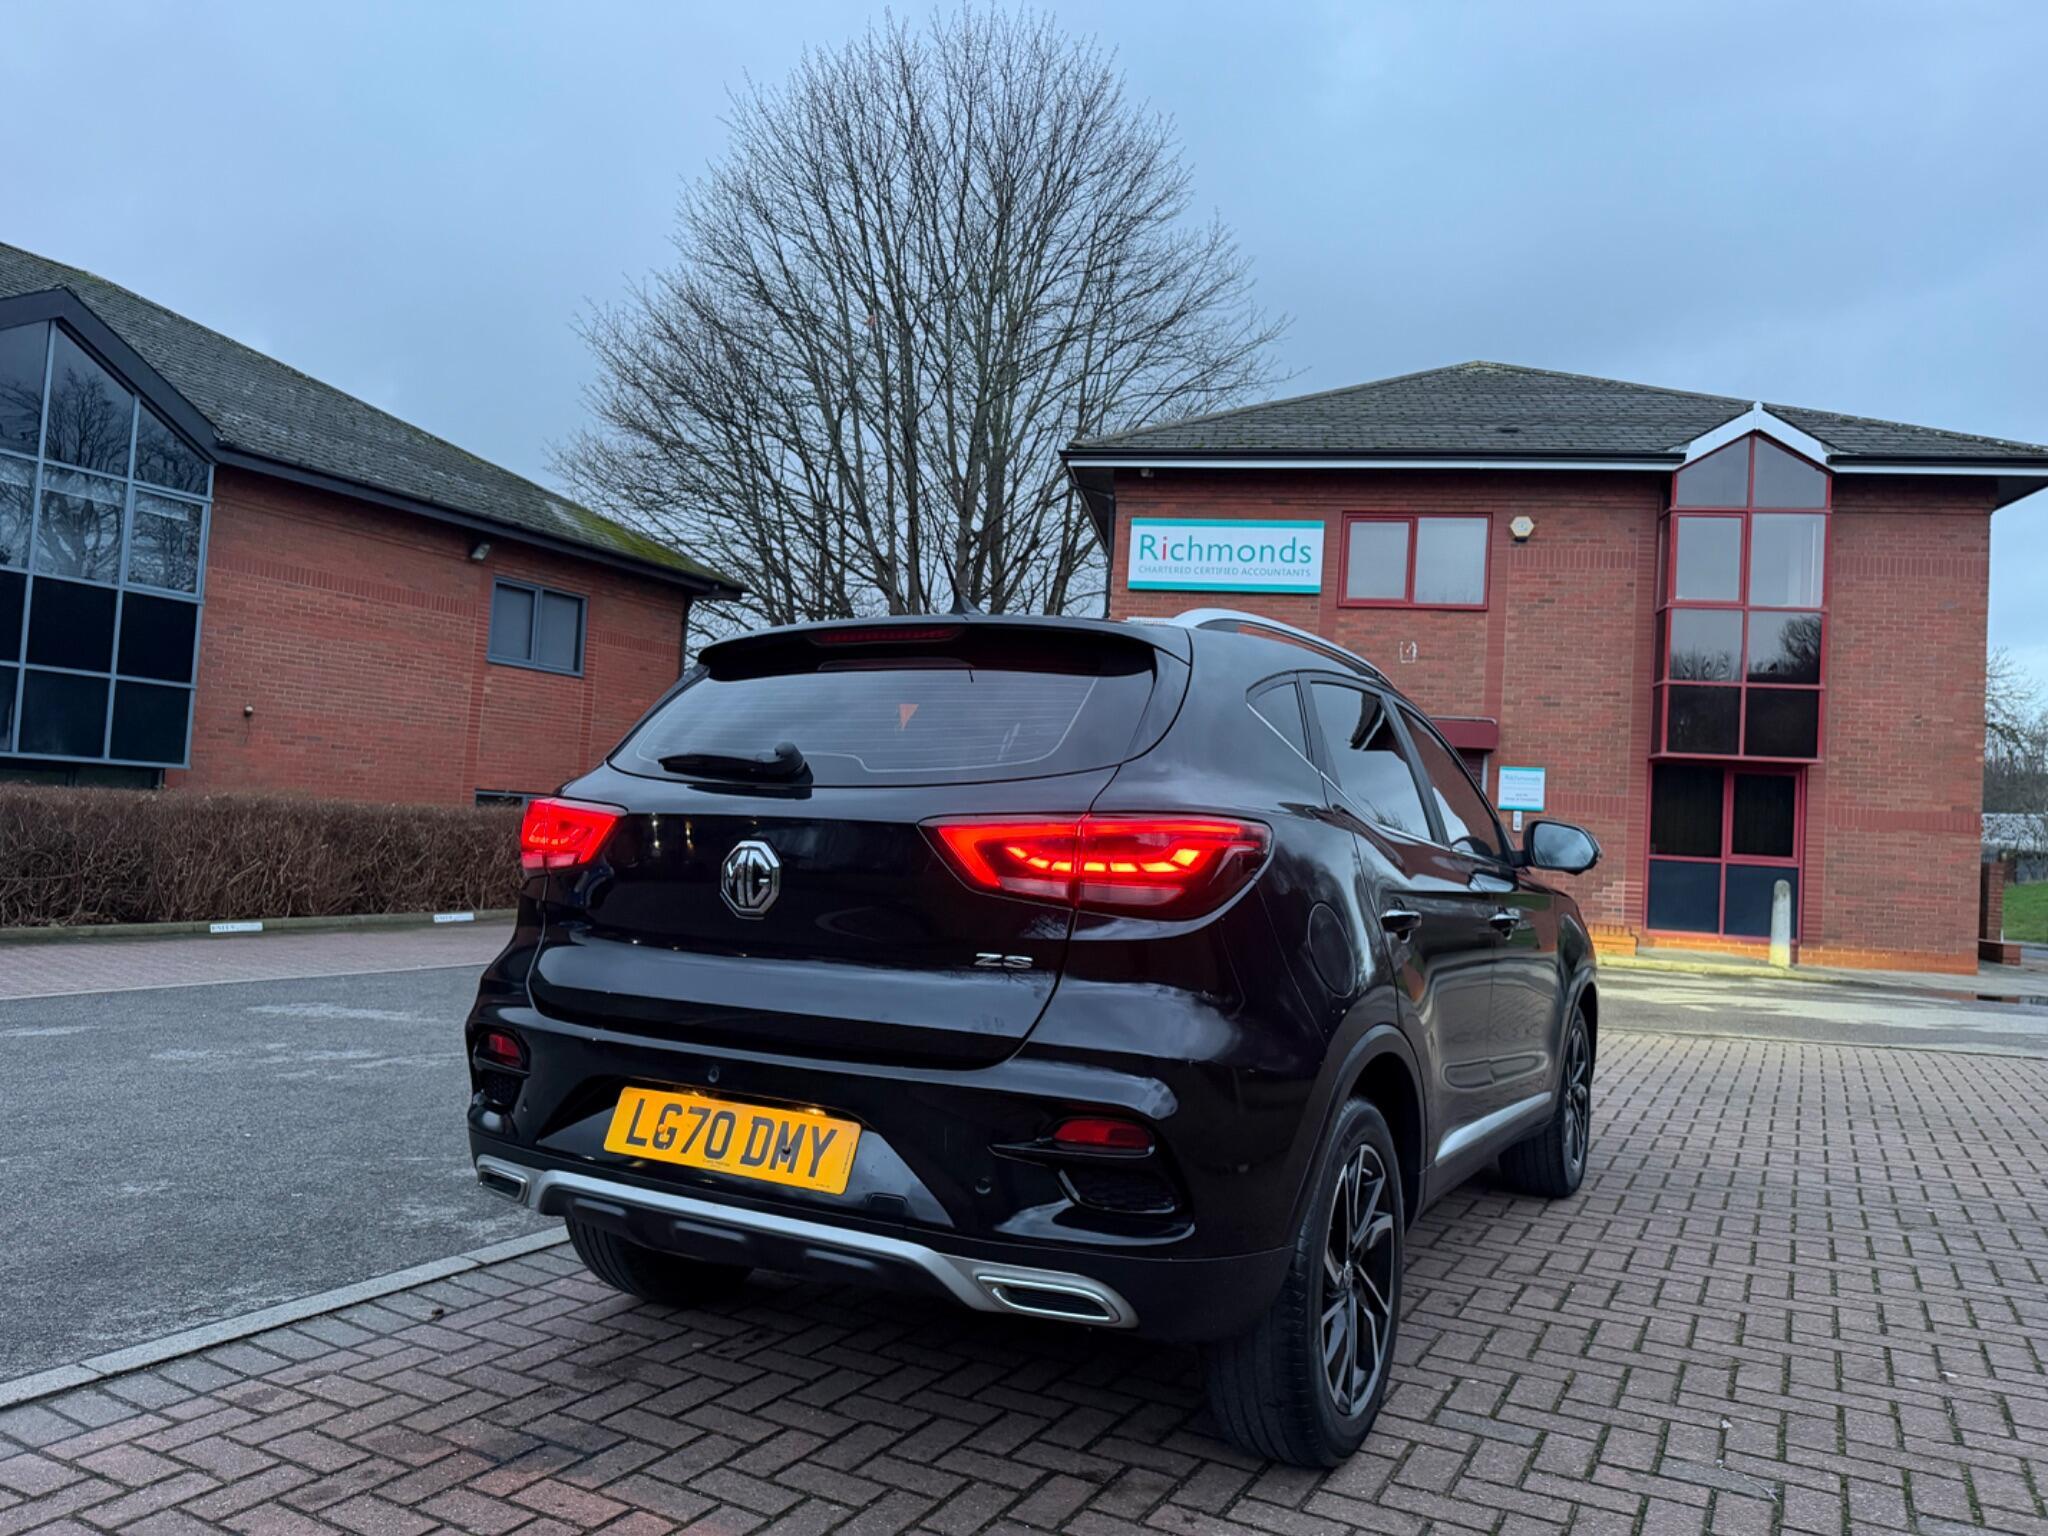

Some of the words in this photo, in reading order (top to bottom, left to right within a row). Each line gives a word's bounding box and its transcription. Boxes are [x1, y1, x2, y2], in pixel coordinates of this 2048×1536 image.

[1138, 534, 1312, 564] Richmonds
[1138, 565, 1191, 575] CHARTERED
[1193, 567, 1239, 577] CERTIFIED
[1241, 567, 1312, 577] ACCOUNTANTS
[726, 848, 771, 906] MG
[974, 952, 1033, 969] ZS
[626, 1098, 736, 1160] LG70
[740, 1115, 838, 1178] DMY
